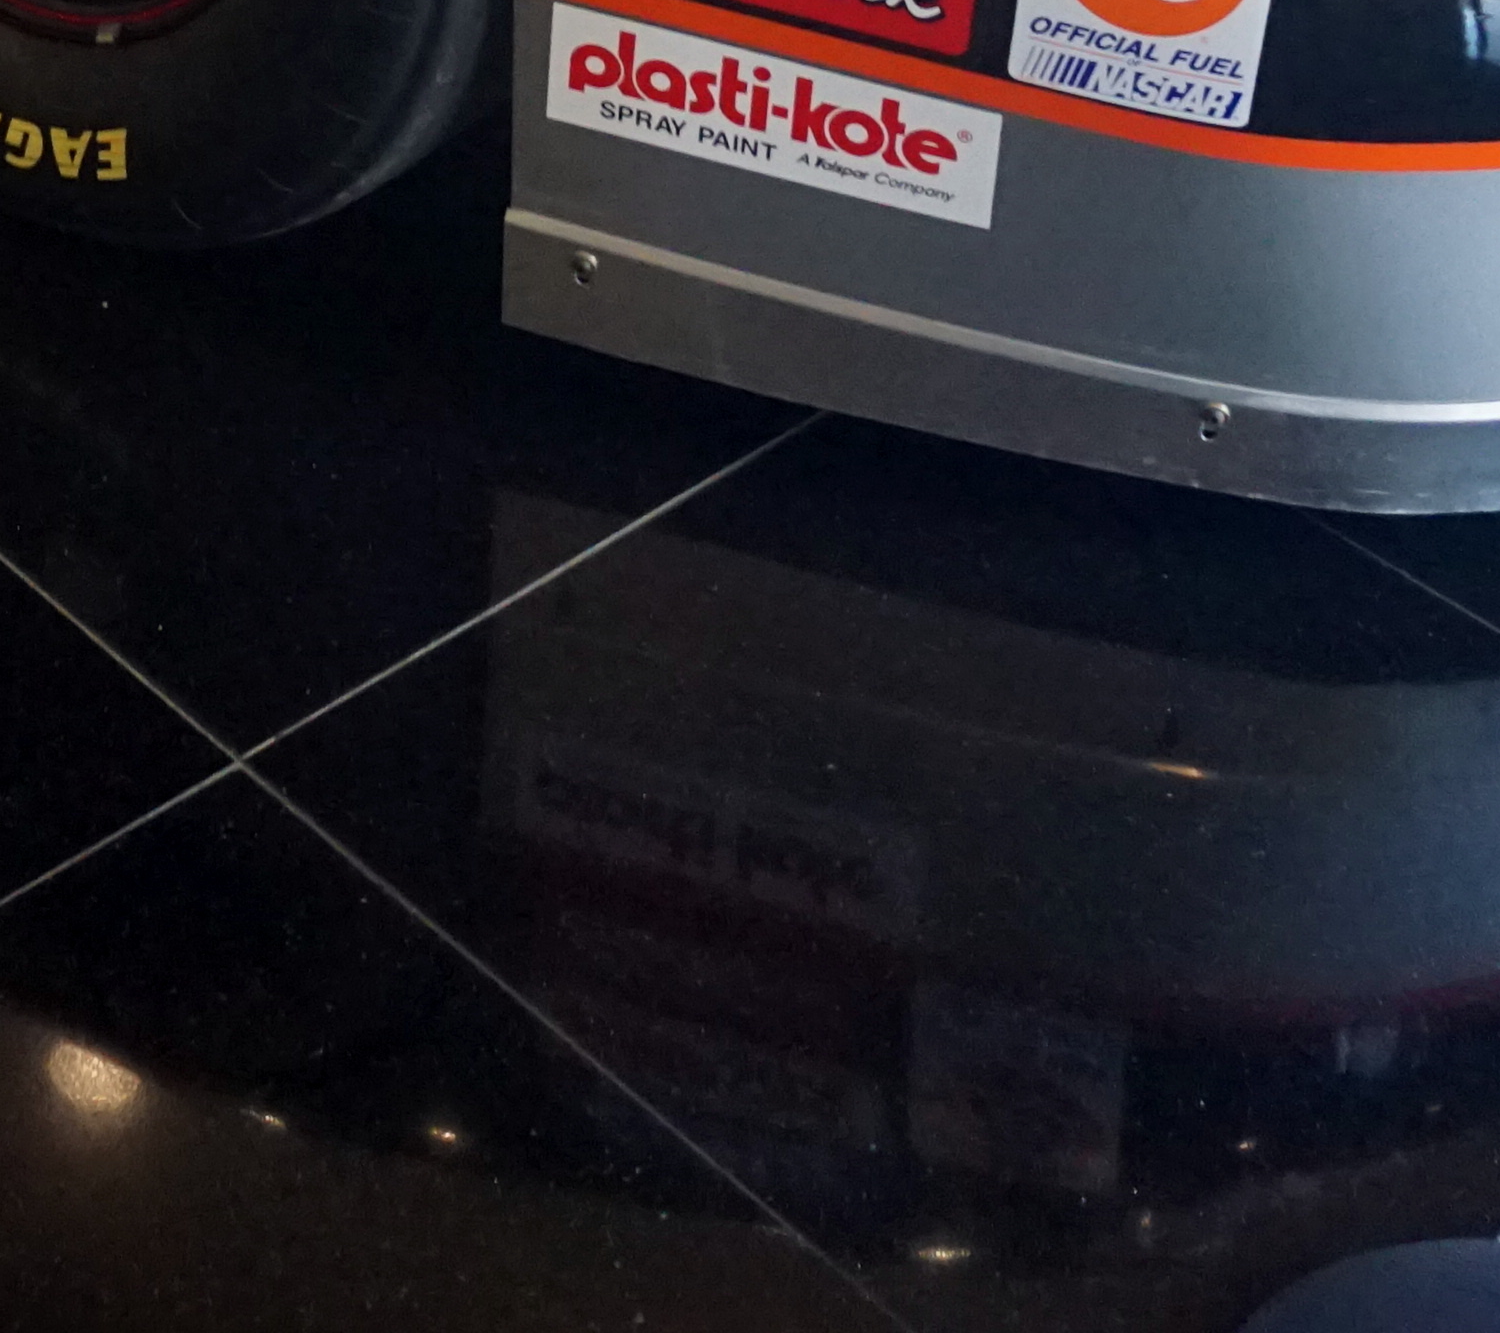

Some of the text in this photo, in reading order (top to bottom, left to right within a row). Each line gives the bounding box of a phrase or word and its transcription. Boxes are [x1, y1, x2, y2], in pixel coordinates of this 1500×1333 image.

[1029, 15, 1245, 80] OFFICIAL FUEL
[567, 29, 959, 177] plasti-kote
[1094, 64, 1244, 122] NASCAR
[599, 99, 778, 162] SPRAY PAINT
[796, 152, 811, 167] A
[874, 171, 957, 204] Company
